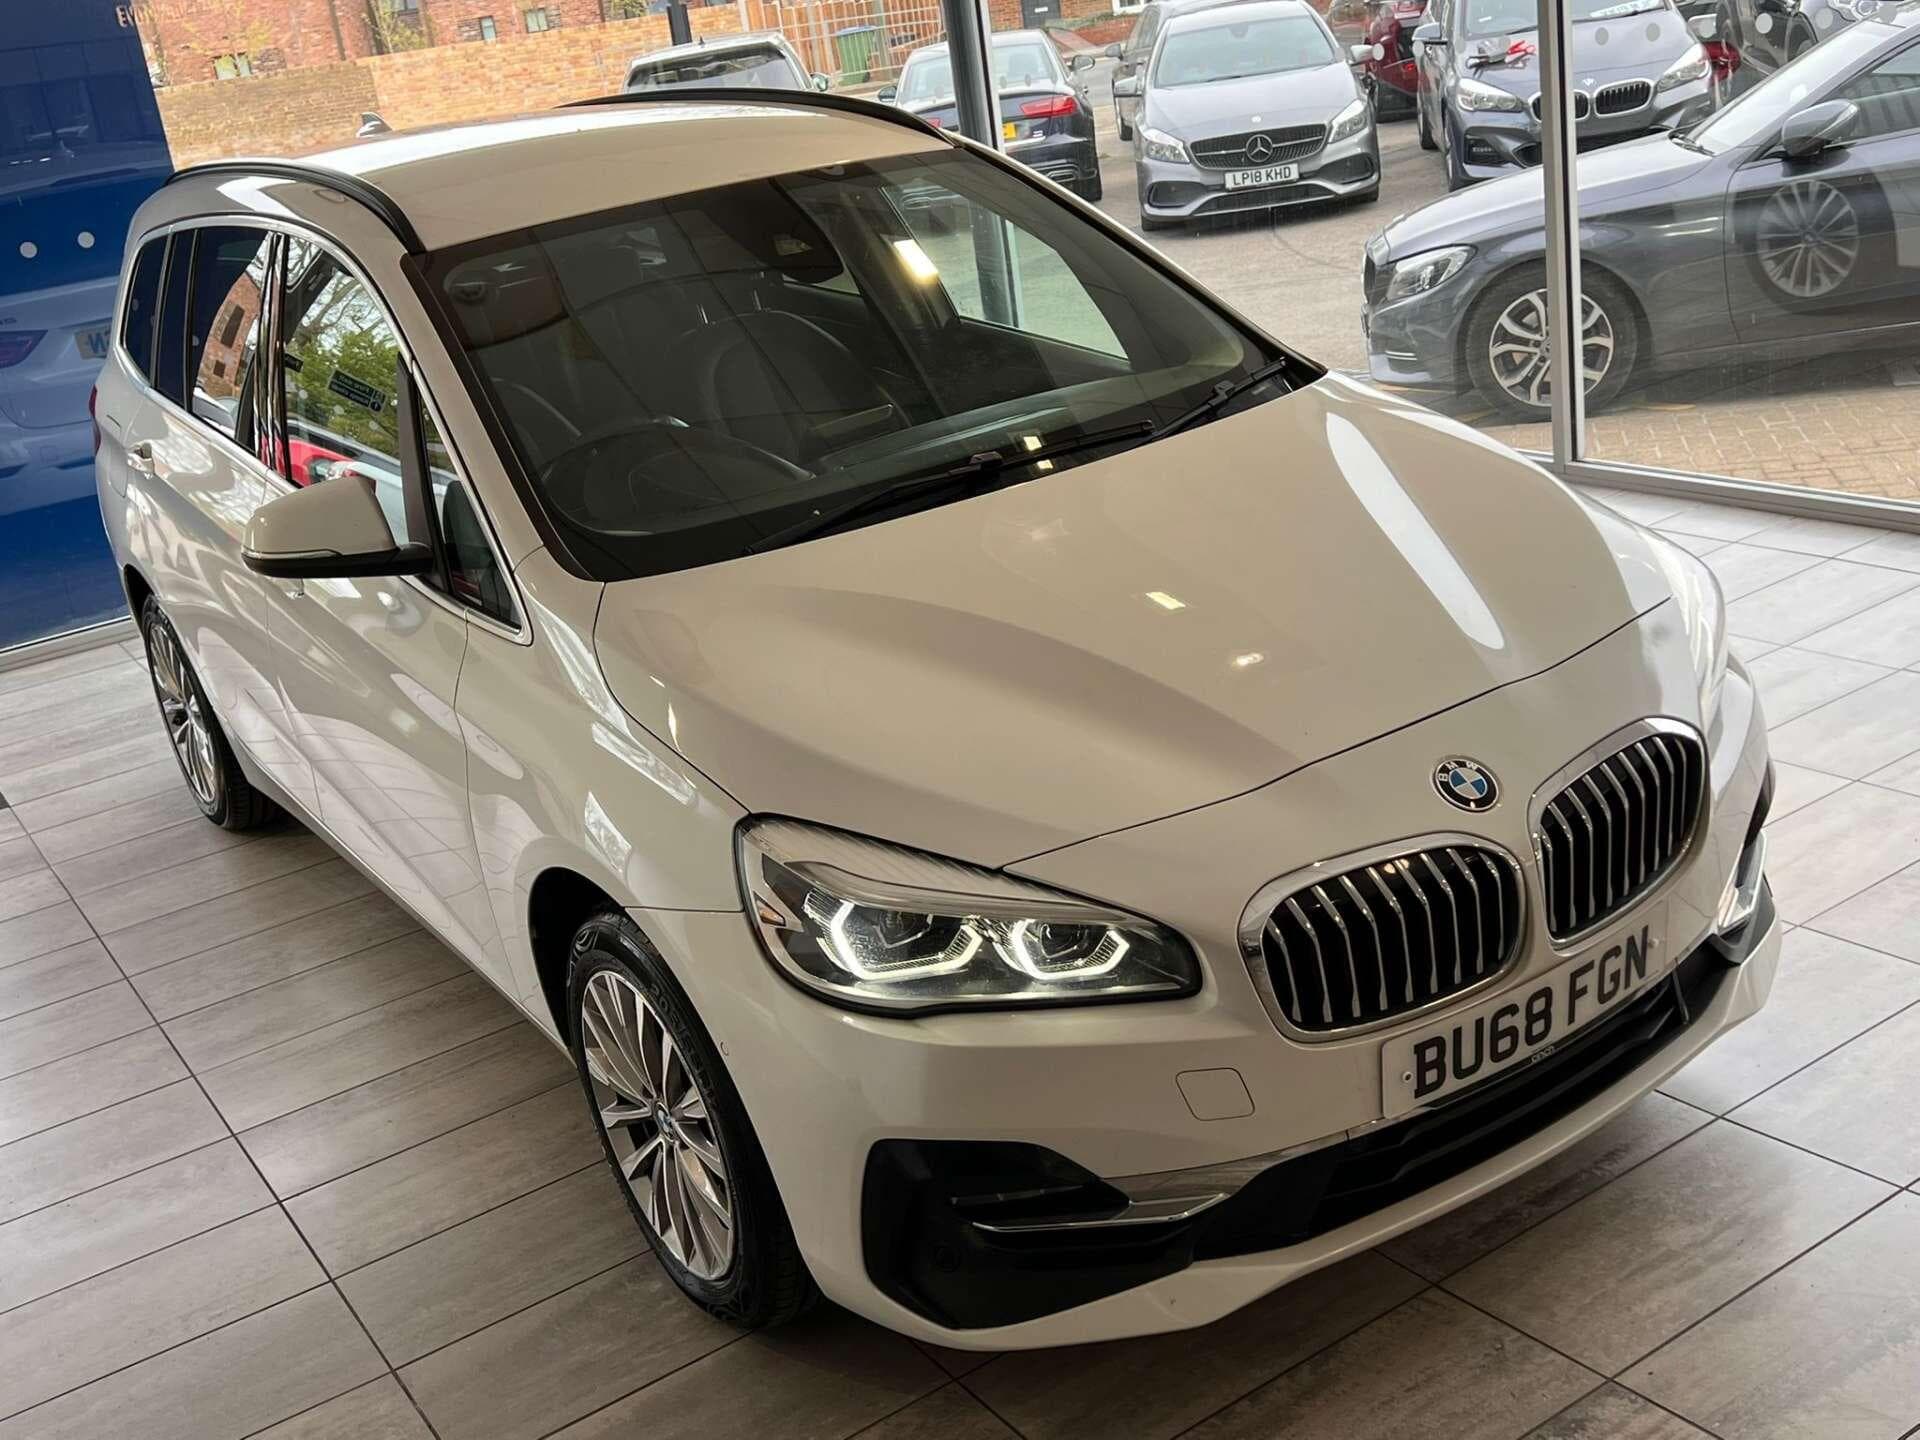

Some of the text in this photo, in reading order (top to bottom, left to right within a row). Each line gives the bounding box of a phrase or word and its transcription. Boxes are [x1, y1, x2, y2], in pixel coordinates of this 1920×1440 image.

[1232, 166, 1291, 186] LP18 KHD
[1413, 925, 1649, 1099] BU68 FGN
